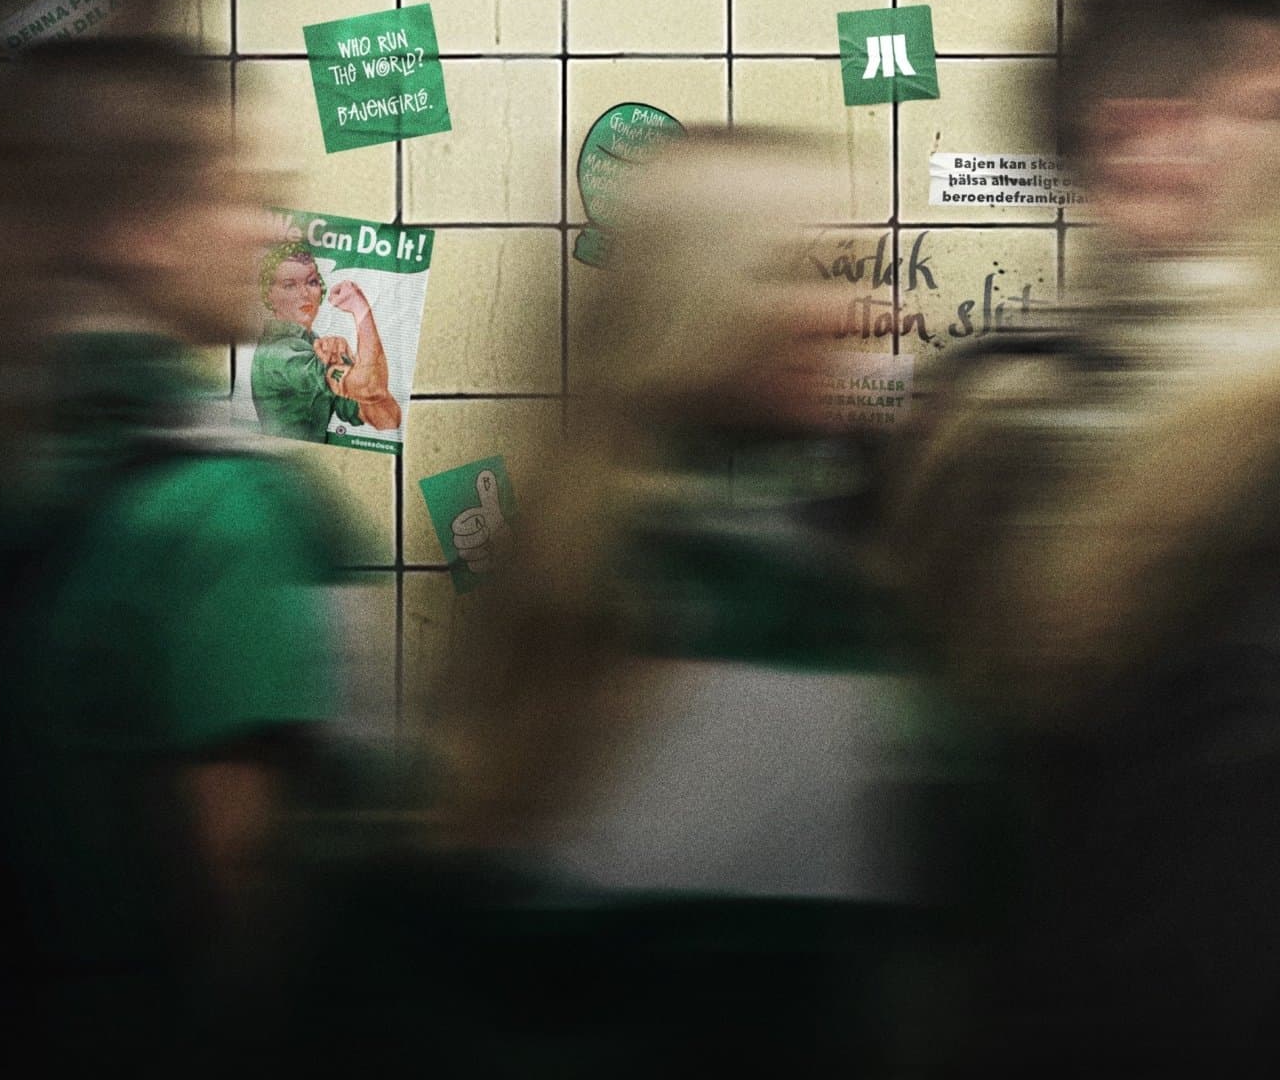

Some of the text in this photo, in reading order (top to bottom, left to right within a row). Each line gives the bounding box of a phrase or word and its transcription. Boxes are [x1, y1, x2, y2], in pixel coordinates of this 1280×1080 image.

[7, 6, 70, 48] DENNA
[337, 29, 409, 59] WHO RUN
[362, 47, 425, 79] WORLD?
[954, 157, 995, 172] Bajen
[999, 157, 1027, 170] kan
[948, 174, 987, 187] hälsa
[991, 174, 1059, 190] allvarligt
[942, 190, 1088, 205] beroendeframkalla
[307, 218, 353, 252] Can
[357, 225, 392, 257] Do
[396, 230, 427, 263] It!
